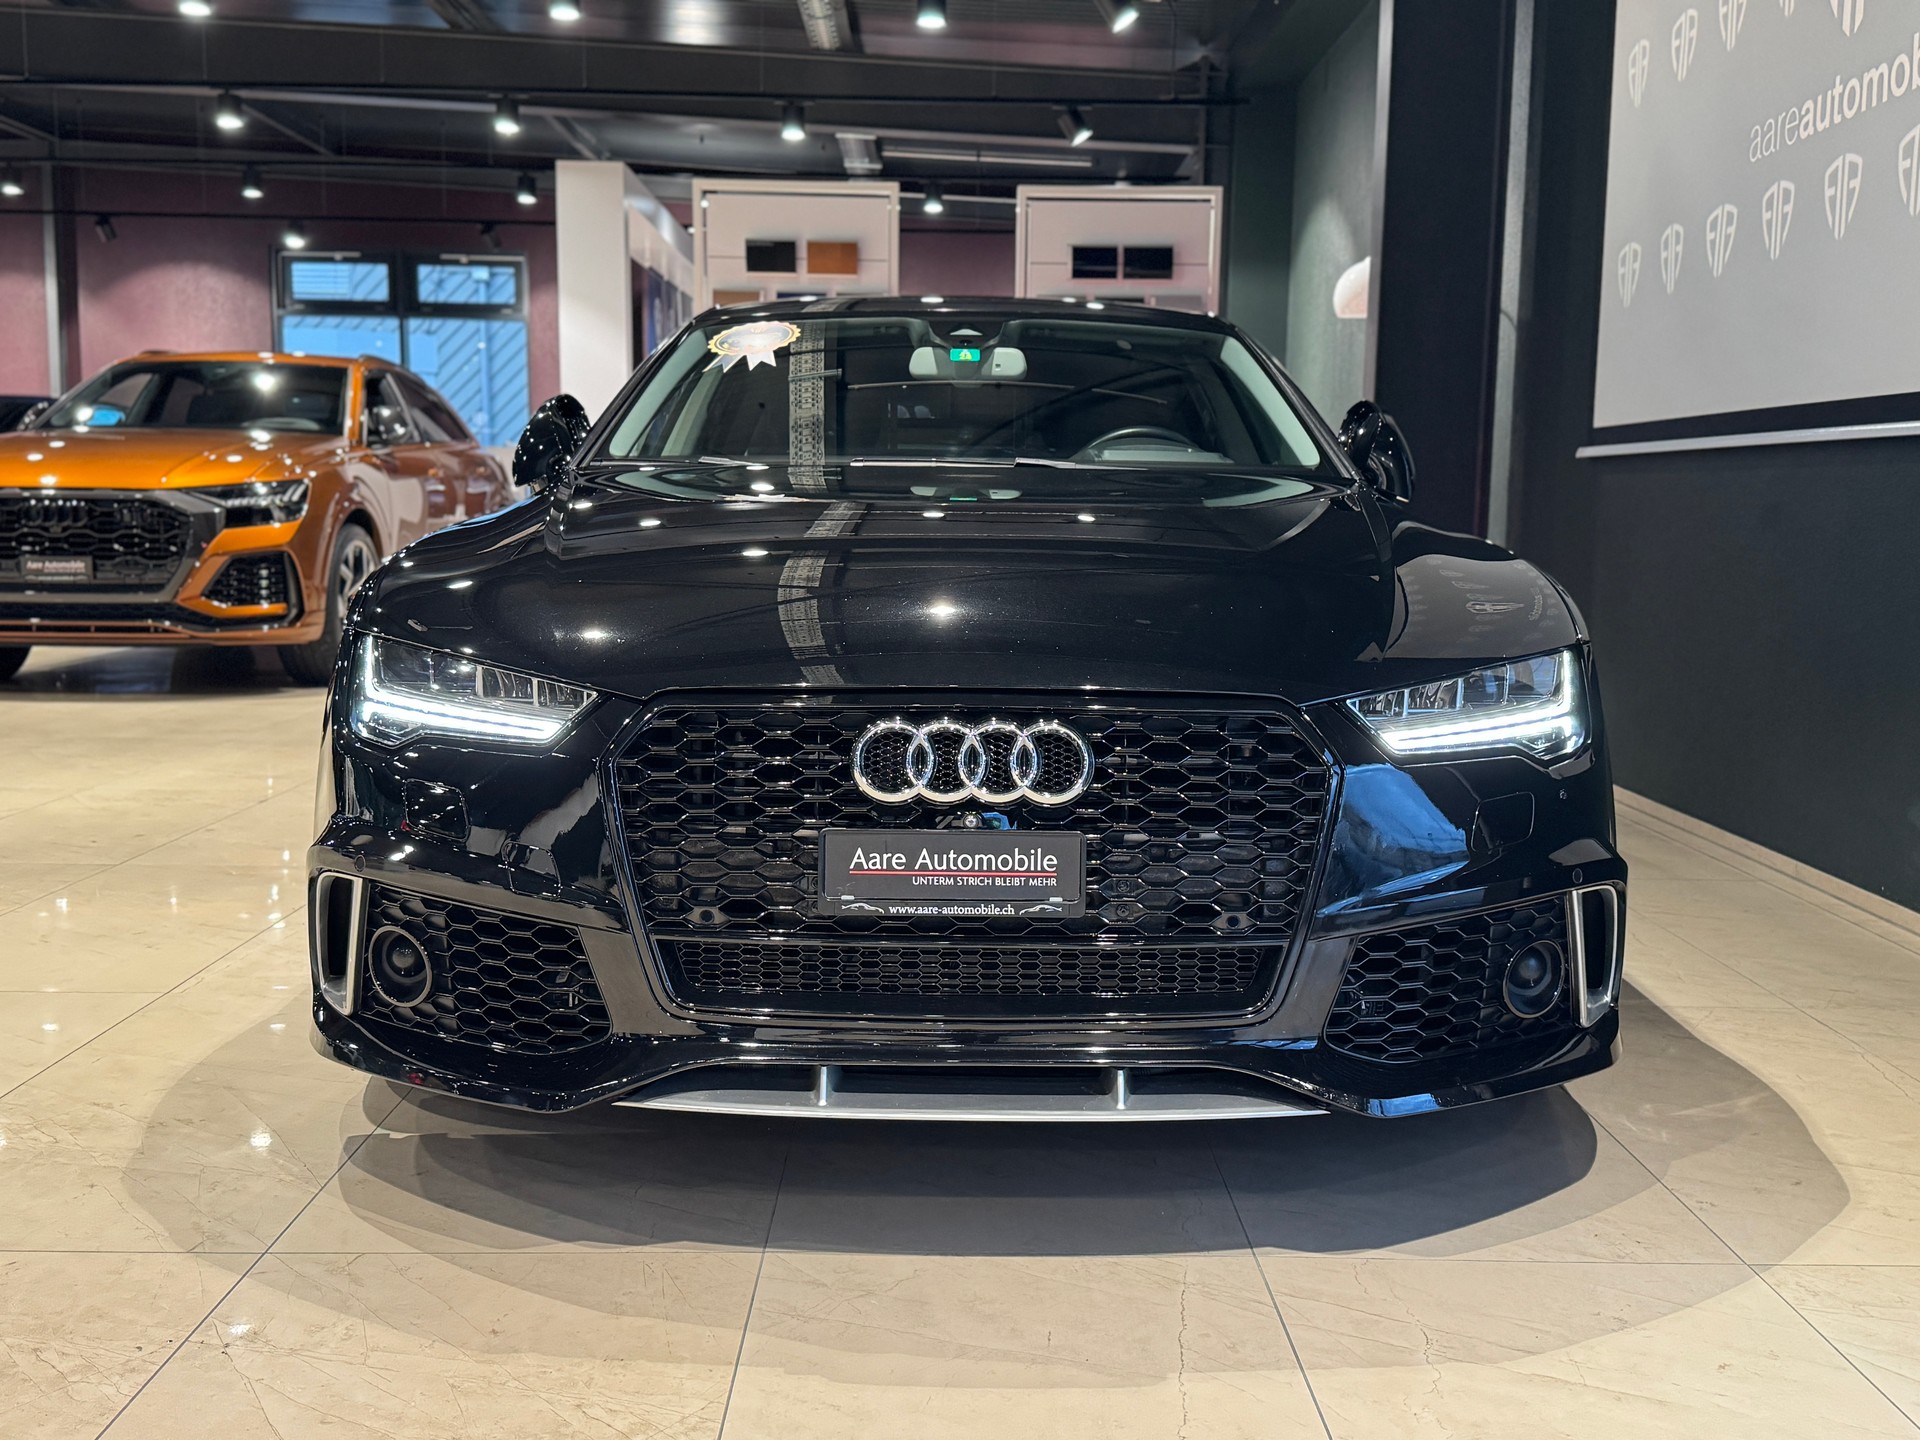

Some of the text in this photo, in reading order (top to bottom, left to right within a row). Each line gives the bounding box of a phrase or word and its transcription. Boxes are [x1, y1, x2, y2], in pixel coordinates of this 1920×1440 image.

[850, 847, 1058, 871] Aare Automobile
[912, 877, 1057, 887] UNTERM STRICH BLEIBT MEHR
[889, 903, 1015, 915] www.aare-automobile.ch
